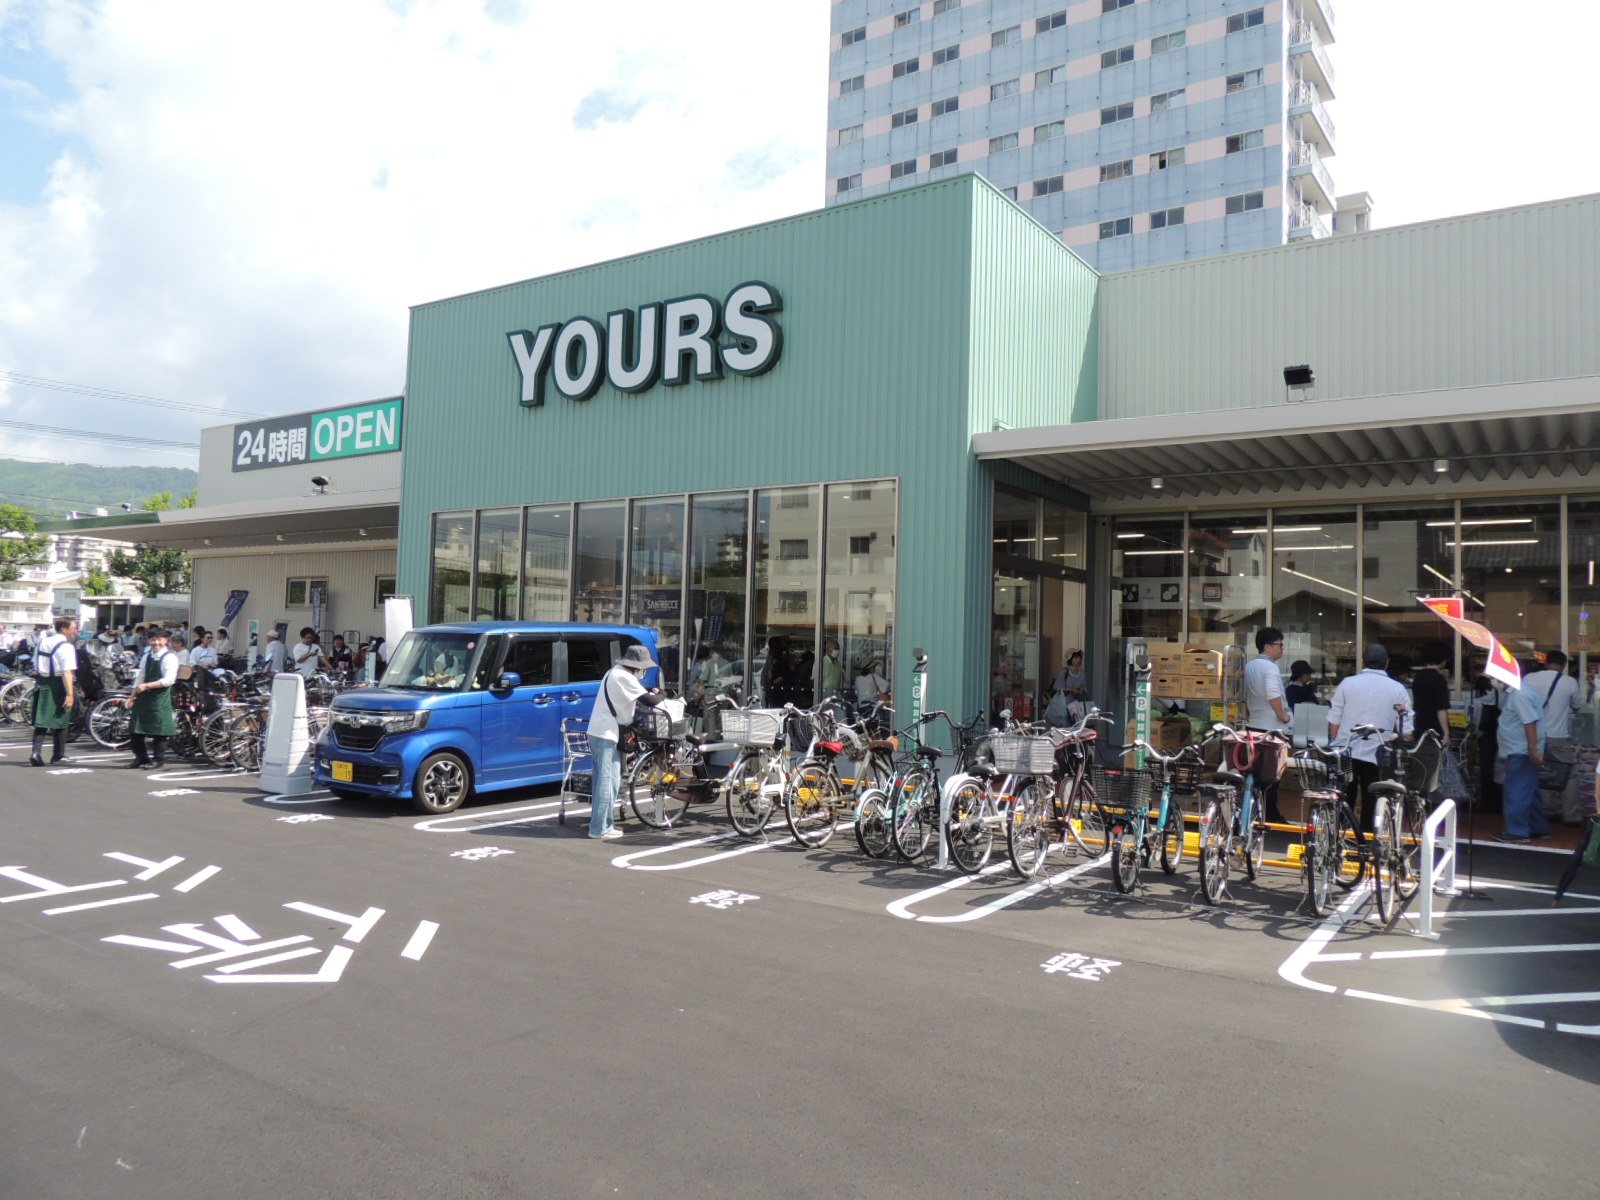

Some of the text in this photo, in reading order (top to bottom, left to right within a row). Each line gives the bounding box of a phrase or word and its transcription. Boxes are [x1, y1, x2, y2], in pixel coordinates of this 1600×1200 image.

[506, 280, 783, 408] YOURS
[236, 407, 396, 466] 24時間 OPEN
[647, 599, 678, 609] SANFRECCE
[1040, 952, 1122, 981] 軽
